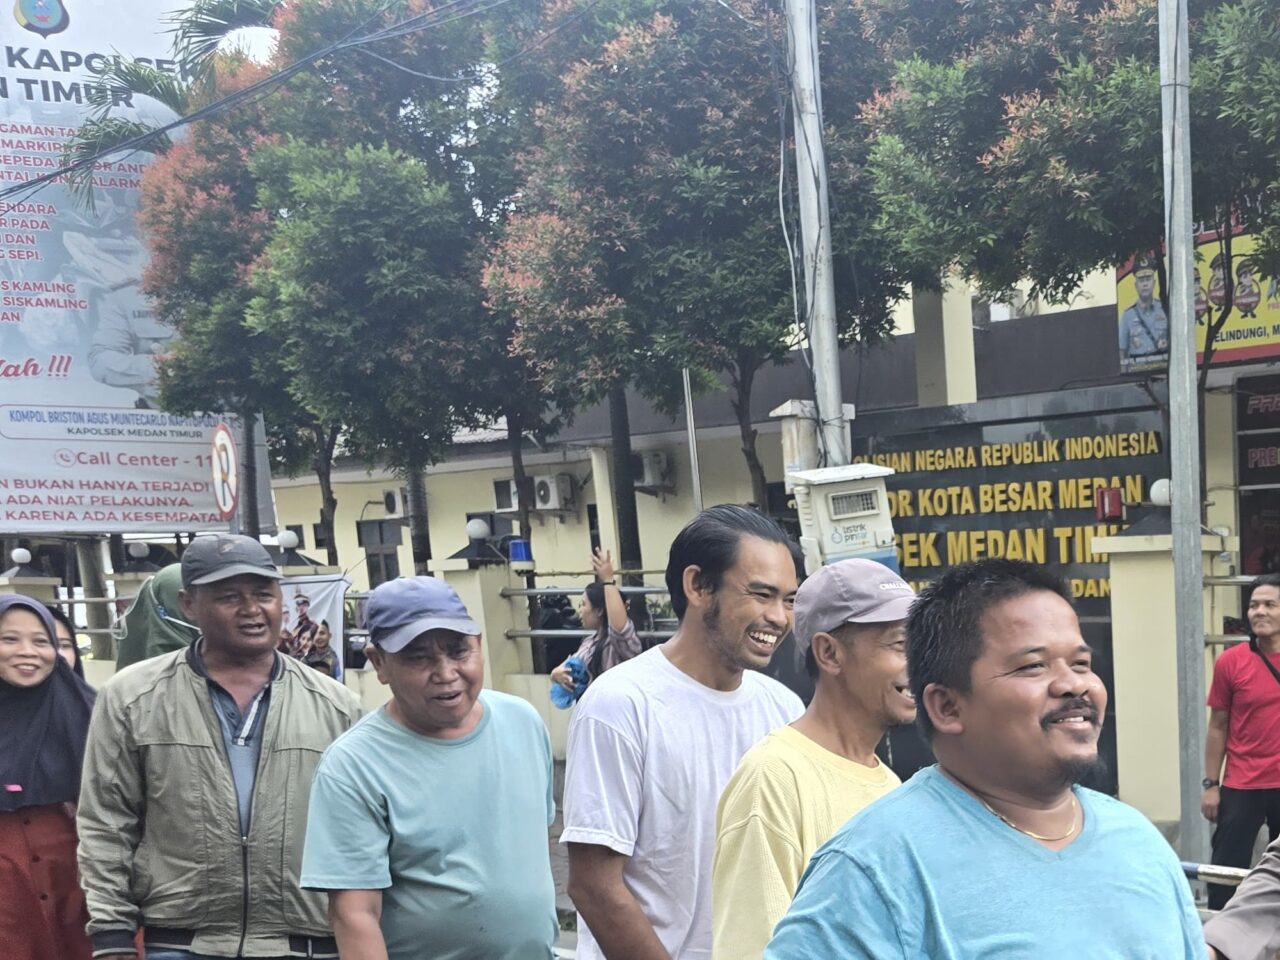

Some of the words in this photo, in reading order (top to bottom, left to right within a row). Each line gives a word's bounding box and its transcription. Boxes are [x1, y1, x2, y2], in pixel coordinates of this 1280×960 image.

[0, 155, 54, 168] EPEDA
[0, 202, 56, 215] ENDARA
[12, 219, 50, 230] PADA
[5, 234, 35, 244] DAN
[13, 282, 75, 293] KAMLING
[3, 297, 87, 309] SISKAMLING
[9, 410, 47, 423] KOMPOL
[48, 411, 86, 424] BRISTON
[67, 427, 125, 436] KAPOLSEK
[127, 428, 167, 437] MEDAN
[169, 430, 203, 439] TIMUR
[915, 446, 976, 472] NEGARA
[981, 439, 1060, 465] REPUBLIK
[1065, 431, 1160, 460] INDONESIA
[77, 451, 111, 465] Call
[117, 453, 178, 467] Center
[14, 479, 73, 490] BUKAN
[79, 480, 138, 491] HANYA
[141, 481, 209, 492] TERJADI
[7, 495, 43, 505] ADA
[47, 495, 86, 506] NIAT
[91, 496, 194, 508] PELAKUNYA.
[918, 487, 976, 517] KOTA
[980, 481, 1053, 513] BESAR
[6, 510, 78, 521] KARENA
[82, 511, 118, 522] ADA
[122, 512, 226, 524] KESEMPATA
